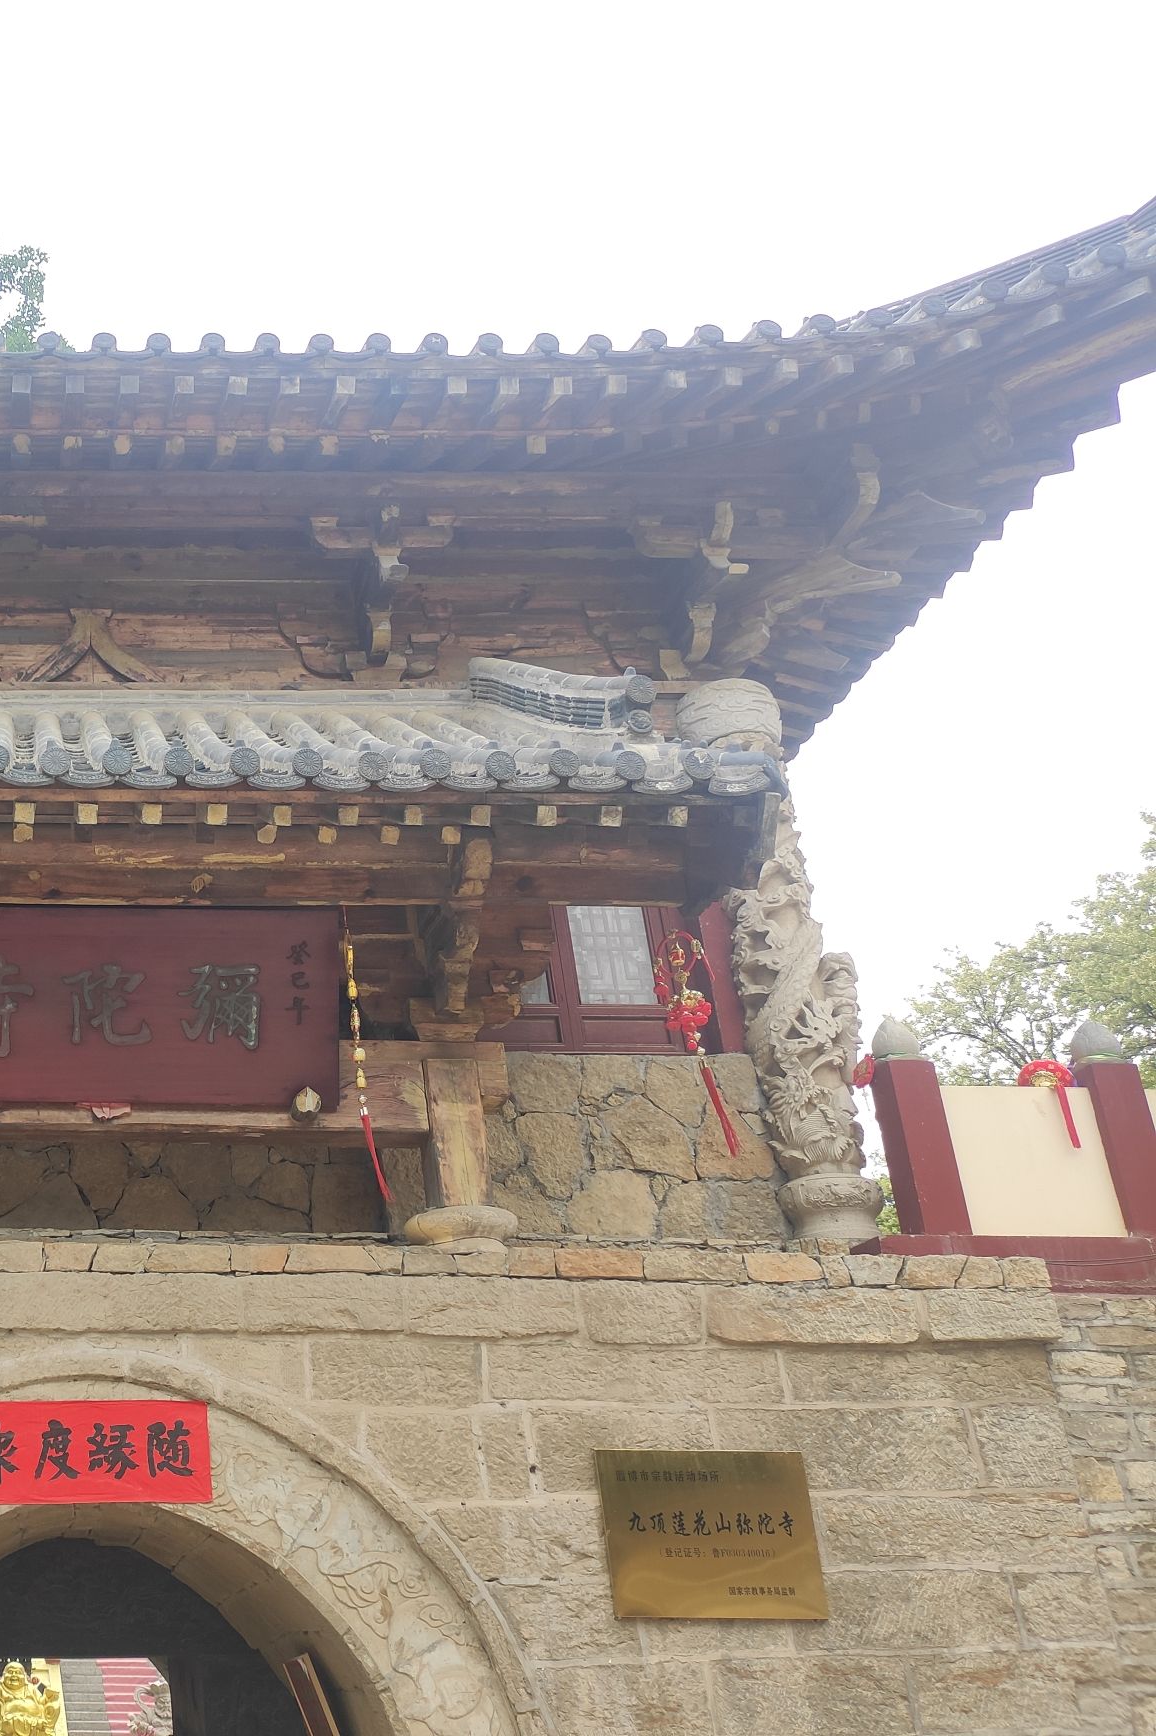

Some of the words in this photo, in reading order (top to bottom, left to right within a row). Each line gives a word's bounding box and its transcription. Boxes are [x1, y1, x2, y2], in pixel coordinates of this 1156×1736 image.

[628, 1509, 795, 1538] 九顶莲花山弥陀寺
[728, 1586, 796, 1597] 国家宗教事务局监制
